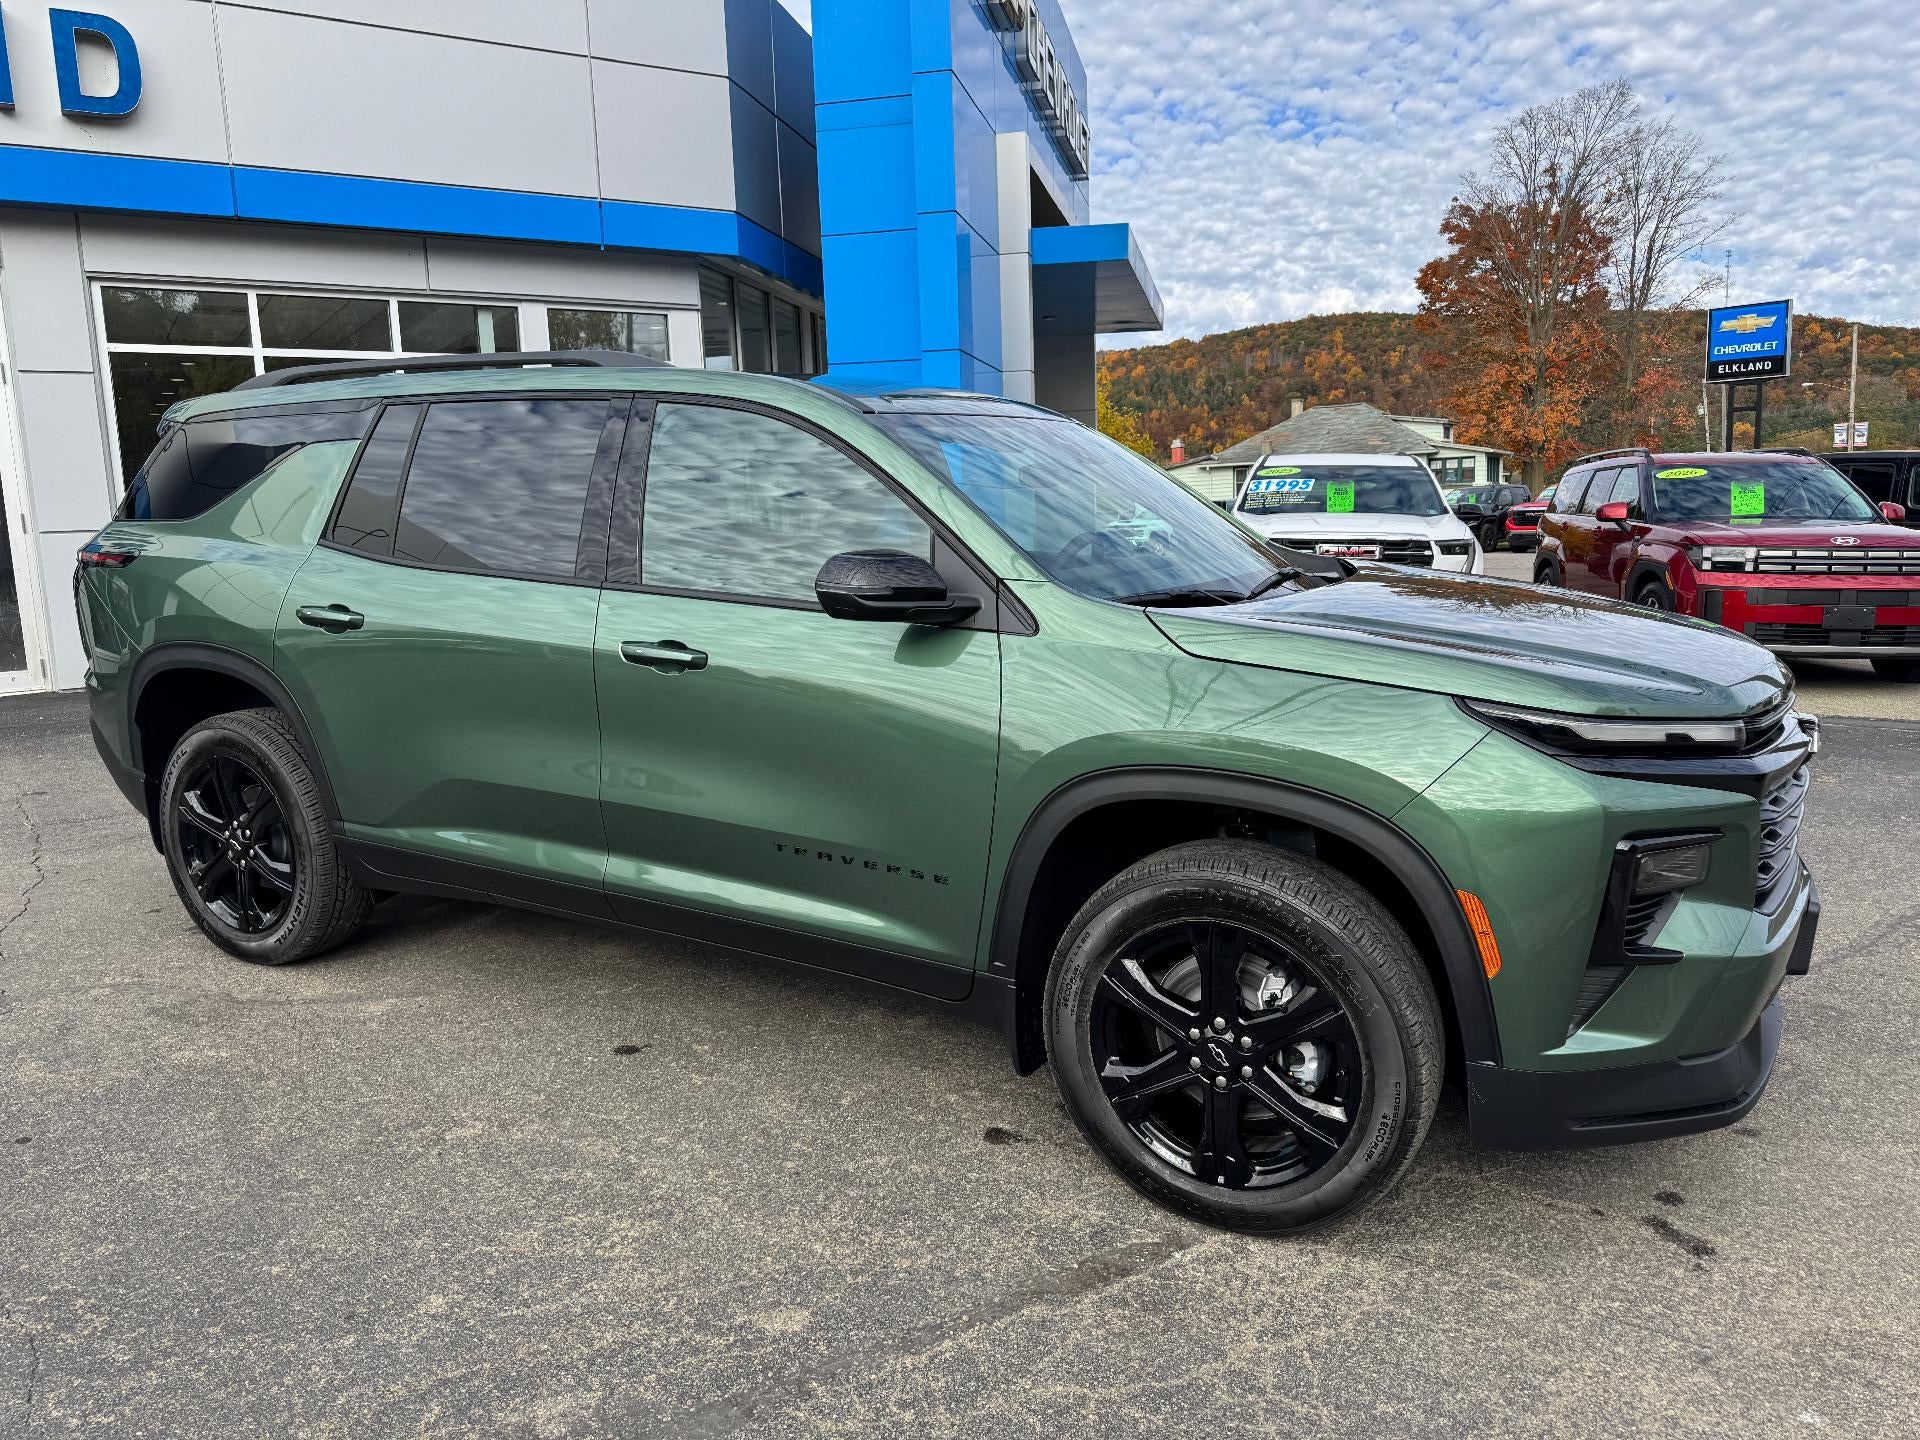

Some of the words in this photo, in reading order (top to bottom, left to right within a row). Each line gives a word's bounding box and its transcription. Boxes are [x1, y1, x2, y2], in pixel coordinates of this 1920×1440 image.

[0, 0, 142, 116] D
[1714, 340, 1779, 355] CHEVROLET
[1717, 360, 1772, 374] ELKLAND
[1264, 467, 1294, 475] 2025
[1665, 469, 1698, 478] 2026
[1248, 480, 1314, 492] 31995
[1319, 545, 1378, 559] GMC
[770, 841, 950, 886] TRAVERSE
